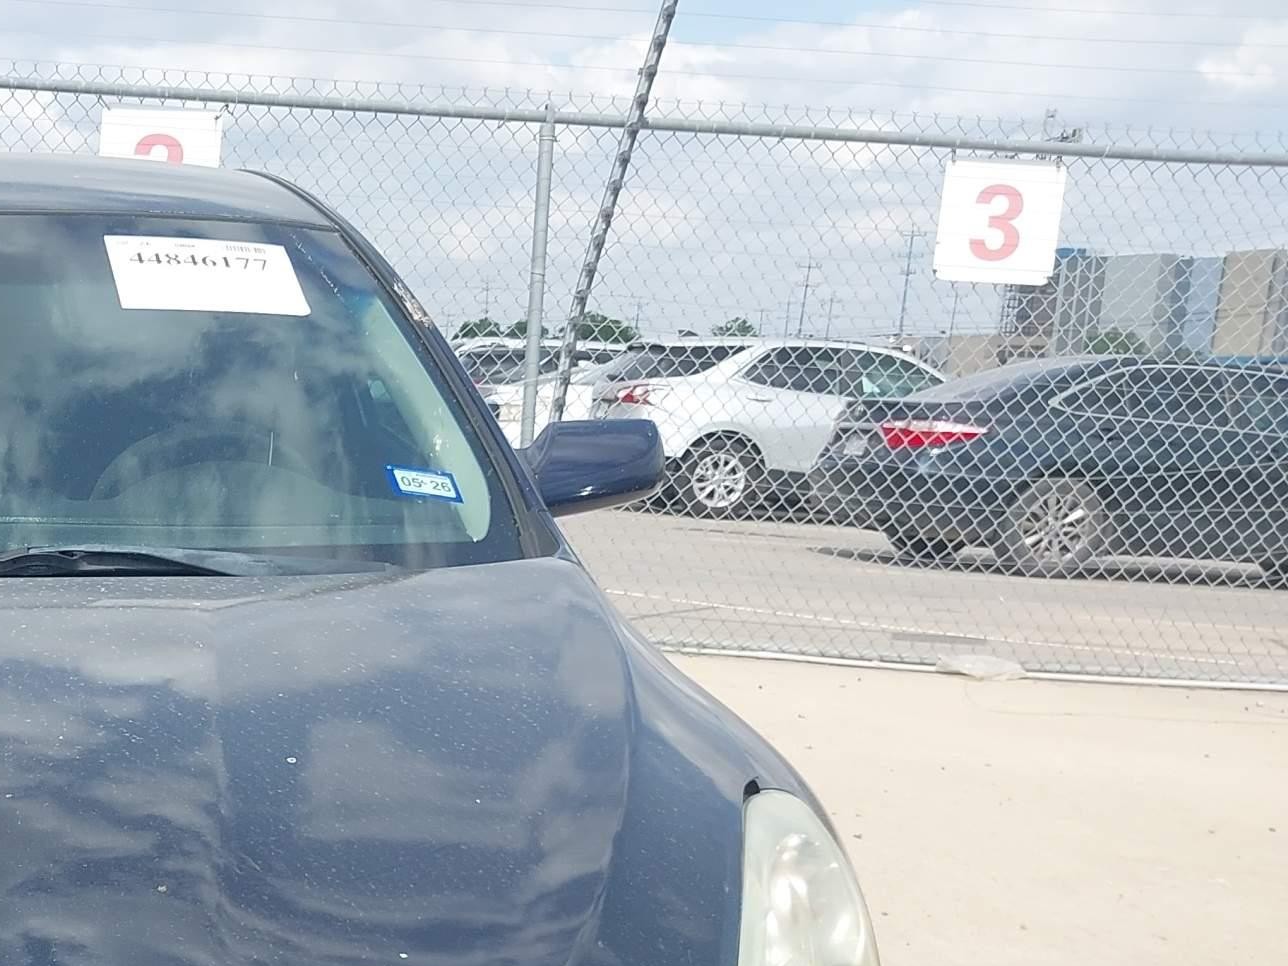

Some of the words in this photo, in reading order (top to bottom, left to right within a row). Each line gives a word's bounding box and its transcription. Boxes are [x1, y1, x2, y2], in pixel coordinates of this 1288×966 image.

[969, 183, 1024, 261] 3
[129, 251, 268, 271] 44846177
[430, 480, 452, 493] 26
